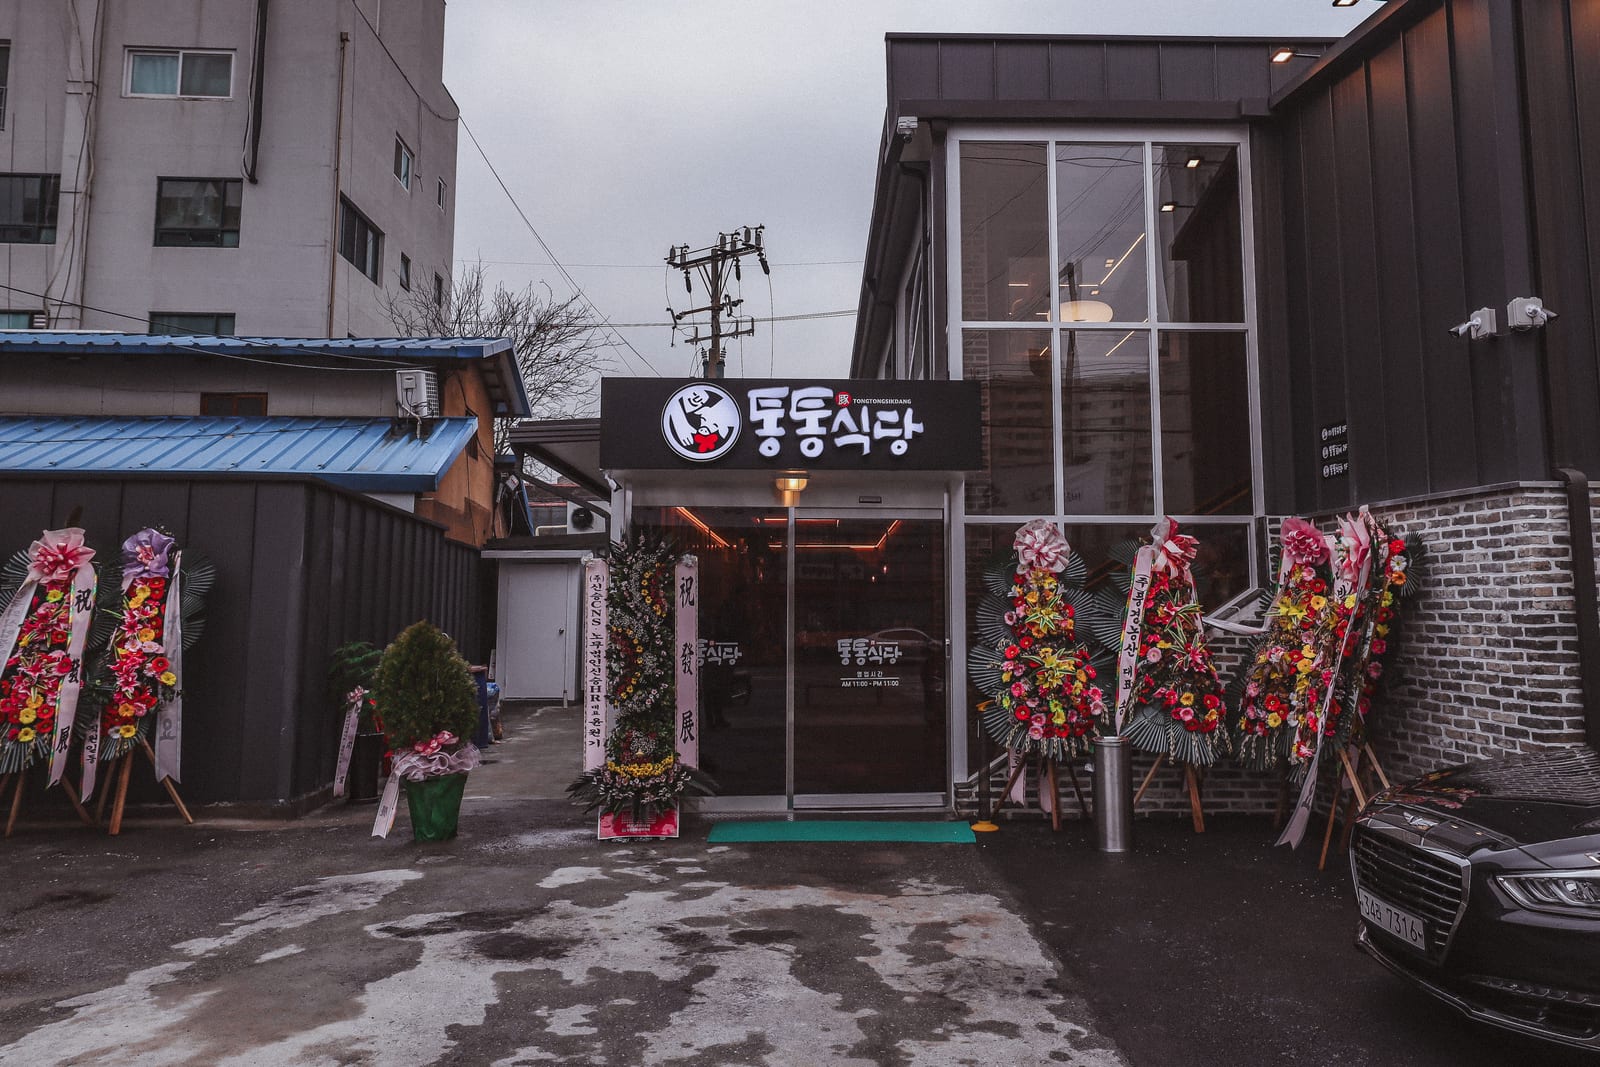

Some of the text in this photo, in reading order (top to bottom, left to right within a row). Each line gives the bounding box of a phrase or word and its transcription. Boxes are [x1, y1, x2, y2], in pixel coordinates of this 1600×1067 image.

[747, 386, 924, 458] 통통식당
[698, 638, 743, 667] 통식당
[837, 638, 903, 666] 통통식당
[1386, 907, 1418, 942] 7316
